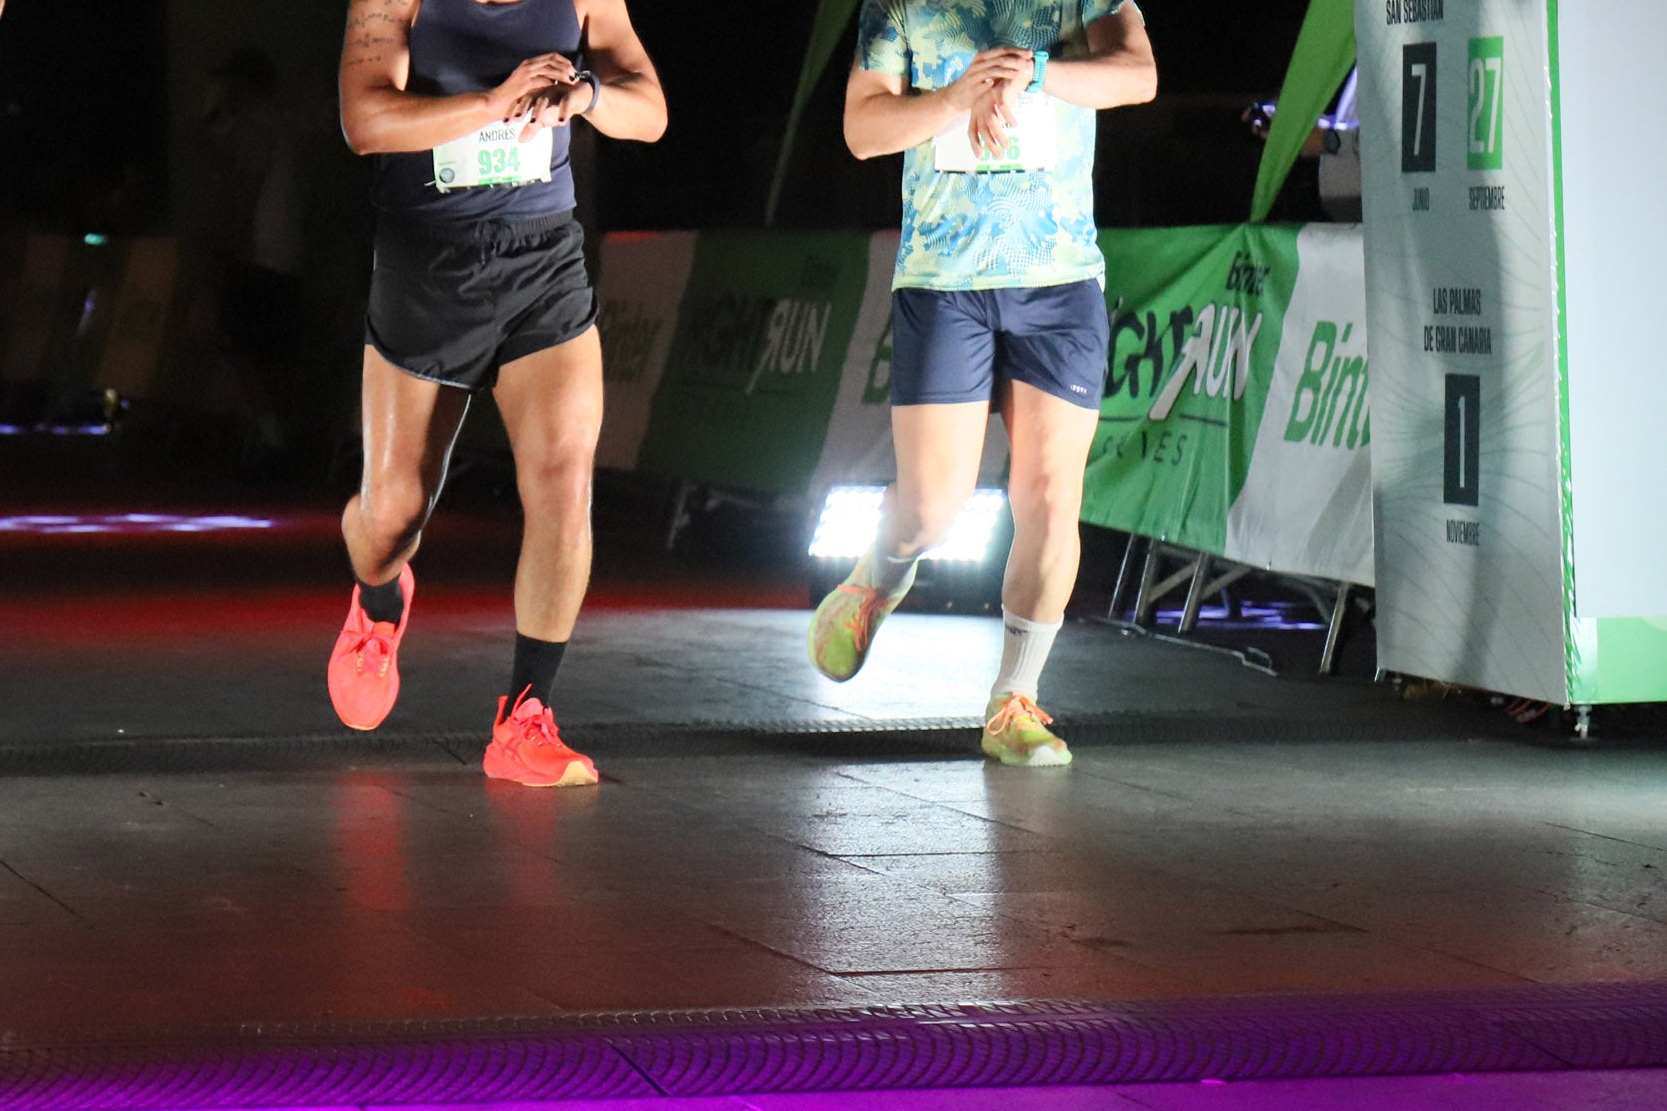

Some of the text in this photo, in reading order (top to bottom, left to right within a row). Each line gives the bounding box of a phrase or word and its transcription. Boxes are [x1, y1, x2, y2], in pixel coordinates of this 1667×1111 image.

[1411, 63, 1426, 156] 7
[1469, 57, 1502, 154] 27
[478, 147, 521, 176] 934
[1468, 186, 1505, 211] SEPTIEMBRE
[1434, 288, 1481, 316] LAS PALMAS
[1424, 325, 1491, 355] DE GRAN CANARIA
[1446, 519, 1480, 548] NOVIEMBRE
